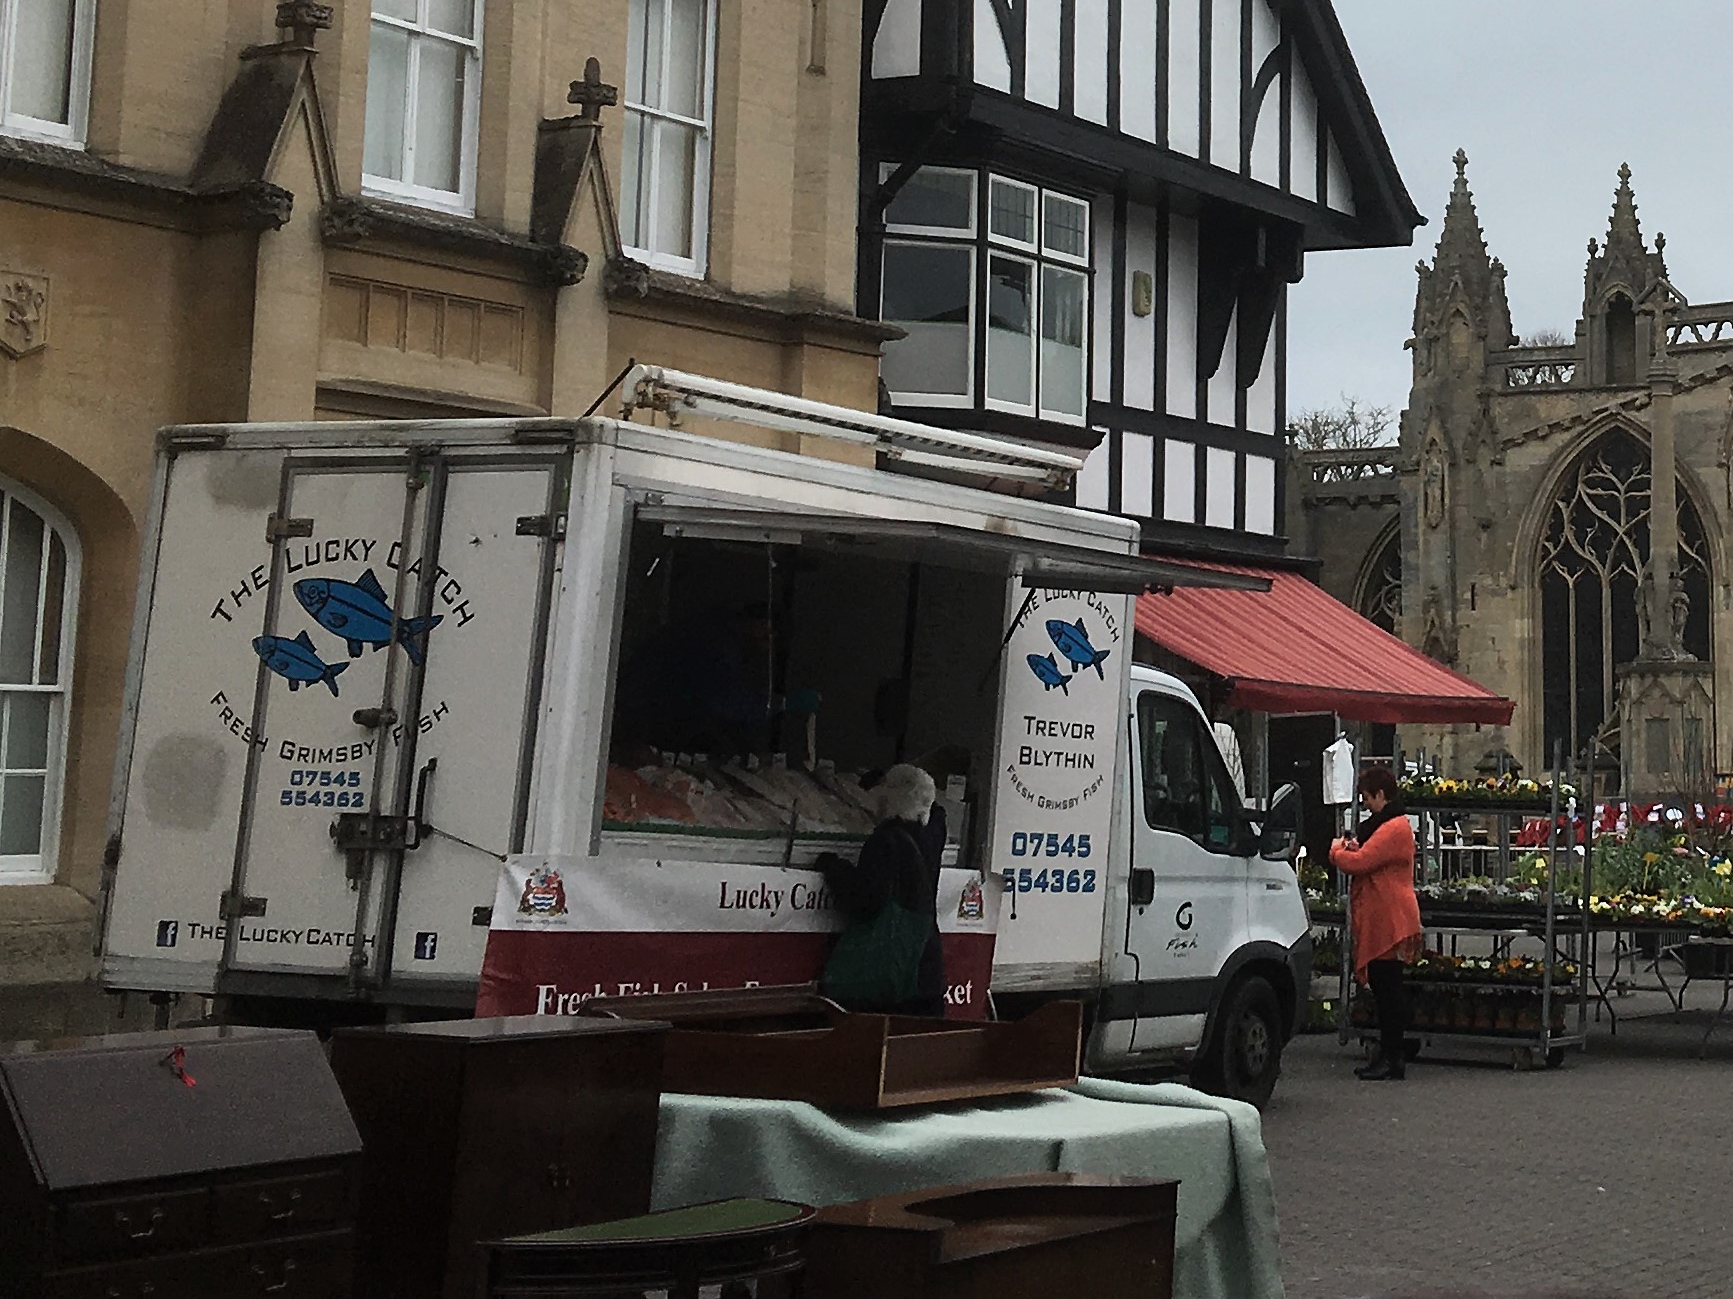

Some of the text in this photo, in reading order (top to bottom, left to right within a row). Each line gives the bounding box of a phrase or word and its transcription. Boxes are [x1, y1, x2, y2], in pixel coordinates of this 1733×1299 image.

[210, 538, 475, 627] THE LUCKY CATCH
[1087, 591, 1120, 643] CATCH
[210, 690, 269, 752] FRESH
[279, 740, 376, 764] GRIMSBY
[1023, 715, 1095, 740] TREVOR
[1019, 746, 1095, 769] BLYTHIN
[290, 769, 361, 788] 07545
[1007, 764, 1104, 810] FRESH GRIMSBY FISH
[280, 789, 364, 808] 554362
[1012, 832, 1091, 858] 07545
[1002, 868, 1096, 893] 554362
[718, 881, 785, 917] Lucky
[188, 923, 226, 940] THE
[239, 925, 303, 944] LUCKY
[306, 928, 376, 948] CATCH
